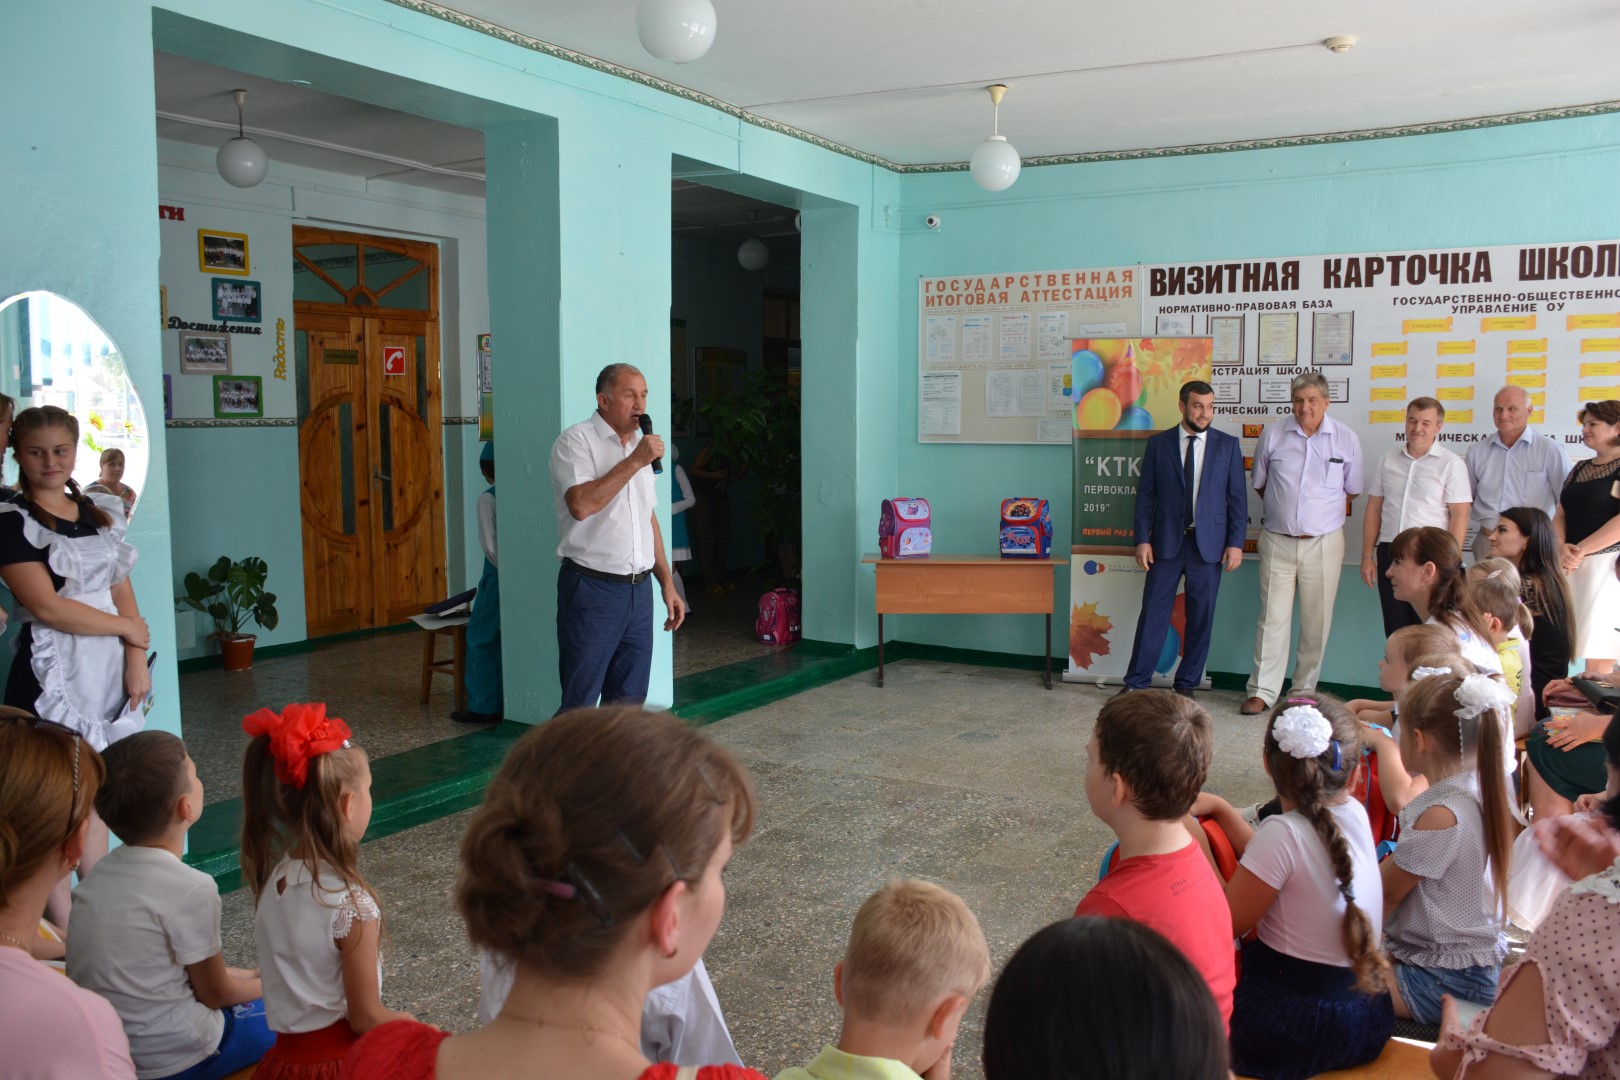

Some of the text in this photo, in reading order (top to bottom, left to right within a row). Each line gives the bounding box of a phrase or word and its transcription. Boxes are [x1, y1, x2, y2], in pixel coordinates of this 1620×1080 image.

[1150, 243, 1620, 296] ВИЗИТНАЯ КАРТОЧКА ШКОЛ
[925, 270, 1133, 293] ГОСУДАРСТВЕННАЯ
[926, 285, 1133, 307] ИТОГОВАЯ АТТЕСТАЦИЯ
[1159, 300, 1333, 314] НОРМАТИВНО-ПРАВОВАЯ БАЗА
[1452, 302, 1566, 314] УПРАВЛЕНИЕ ОУ
[168, 316, 262, 335] Достижения
[273, 317, 287, 381] Радость
[1212, 366, 1322, 377] ИСТРАЦИЯ ШКОЛЫ
[1213, 405, 1269, 415] ГИЧЕСКИЙ
[1084, 485, 1137, 495] ПЕРВОКЛА
[1082, 527, 1112, 536] ПЕРВЫЙ
[1113, 529, 1127, 537] РАЗ
